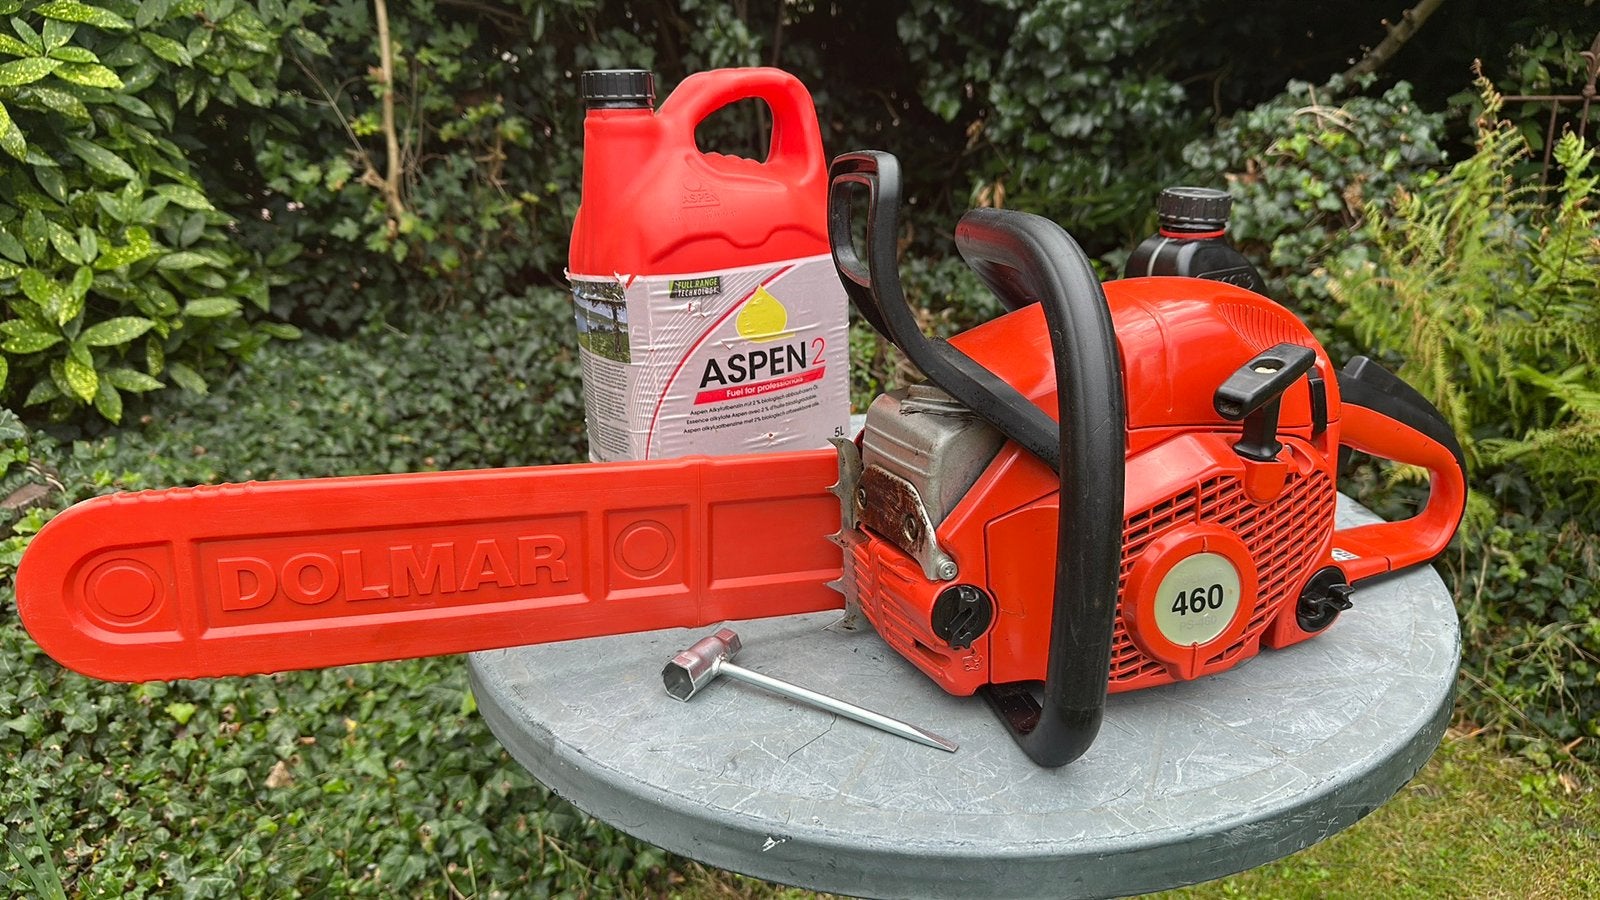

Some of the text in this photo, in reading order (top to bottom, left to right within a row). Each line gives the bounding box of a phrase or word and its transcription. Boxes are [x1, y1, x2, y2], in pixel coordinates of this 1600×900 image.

[677, 277, 719, 290] FULL RANGE
[699, 337, 826, 388] ASPEN 2
[726, 377, 804, 398] Fuel for professionals
[686, 416, 709, 425] Essence
[709, 412, 731, 422] alkylate
[731, 410, 748, 418] Aspen
[690, 408, 709, 416] Aspen
[834, 425, 845, 438] 5L
[217, 534, 570, 611] DOLMAR
[1171, 583, 1224, 616] 460
